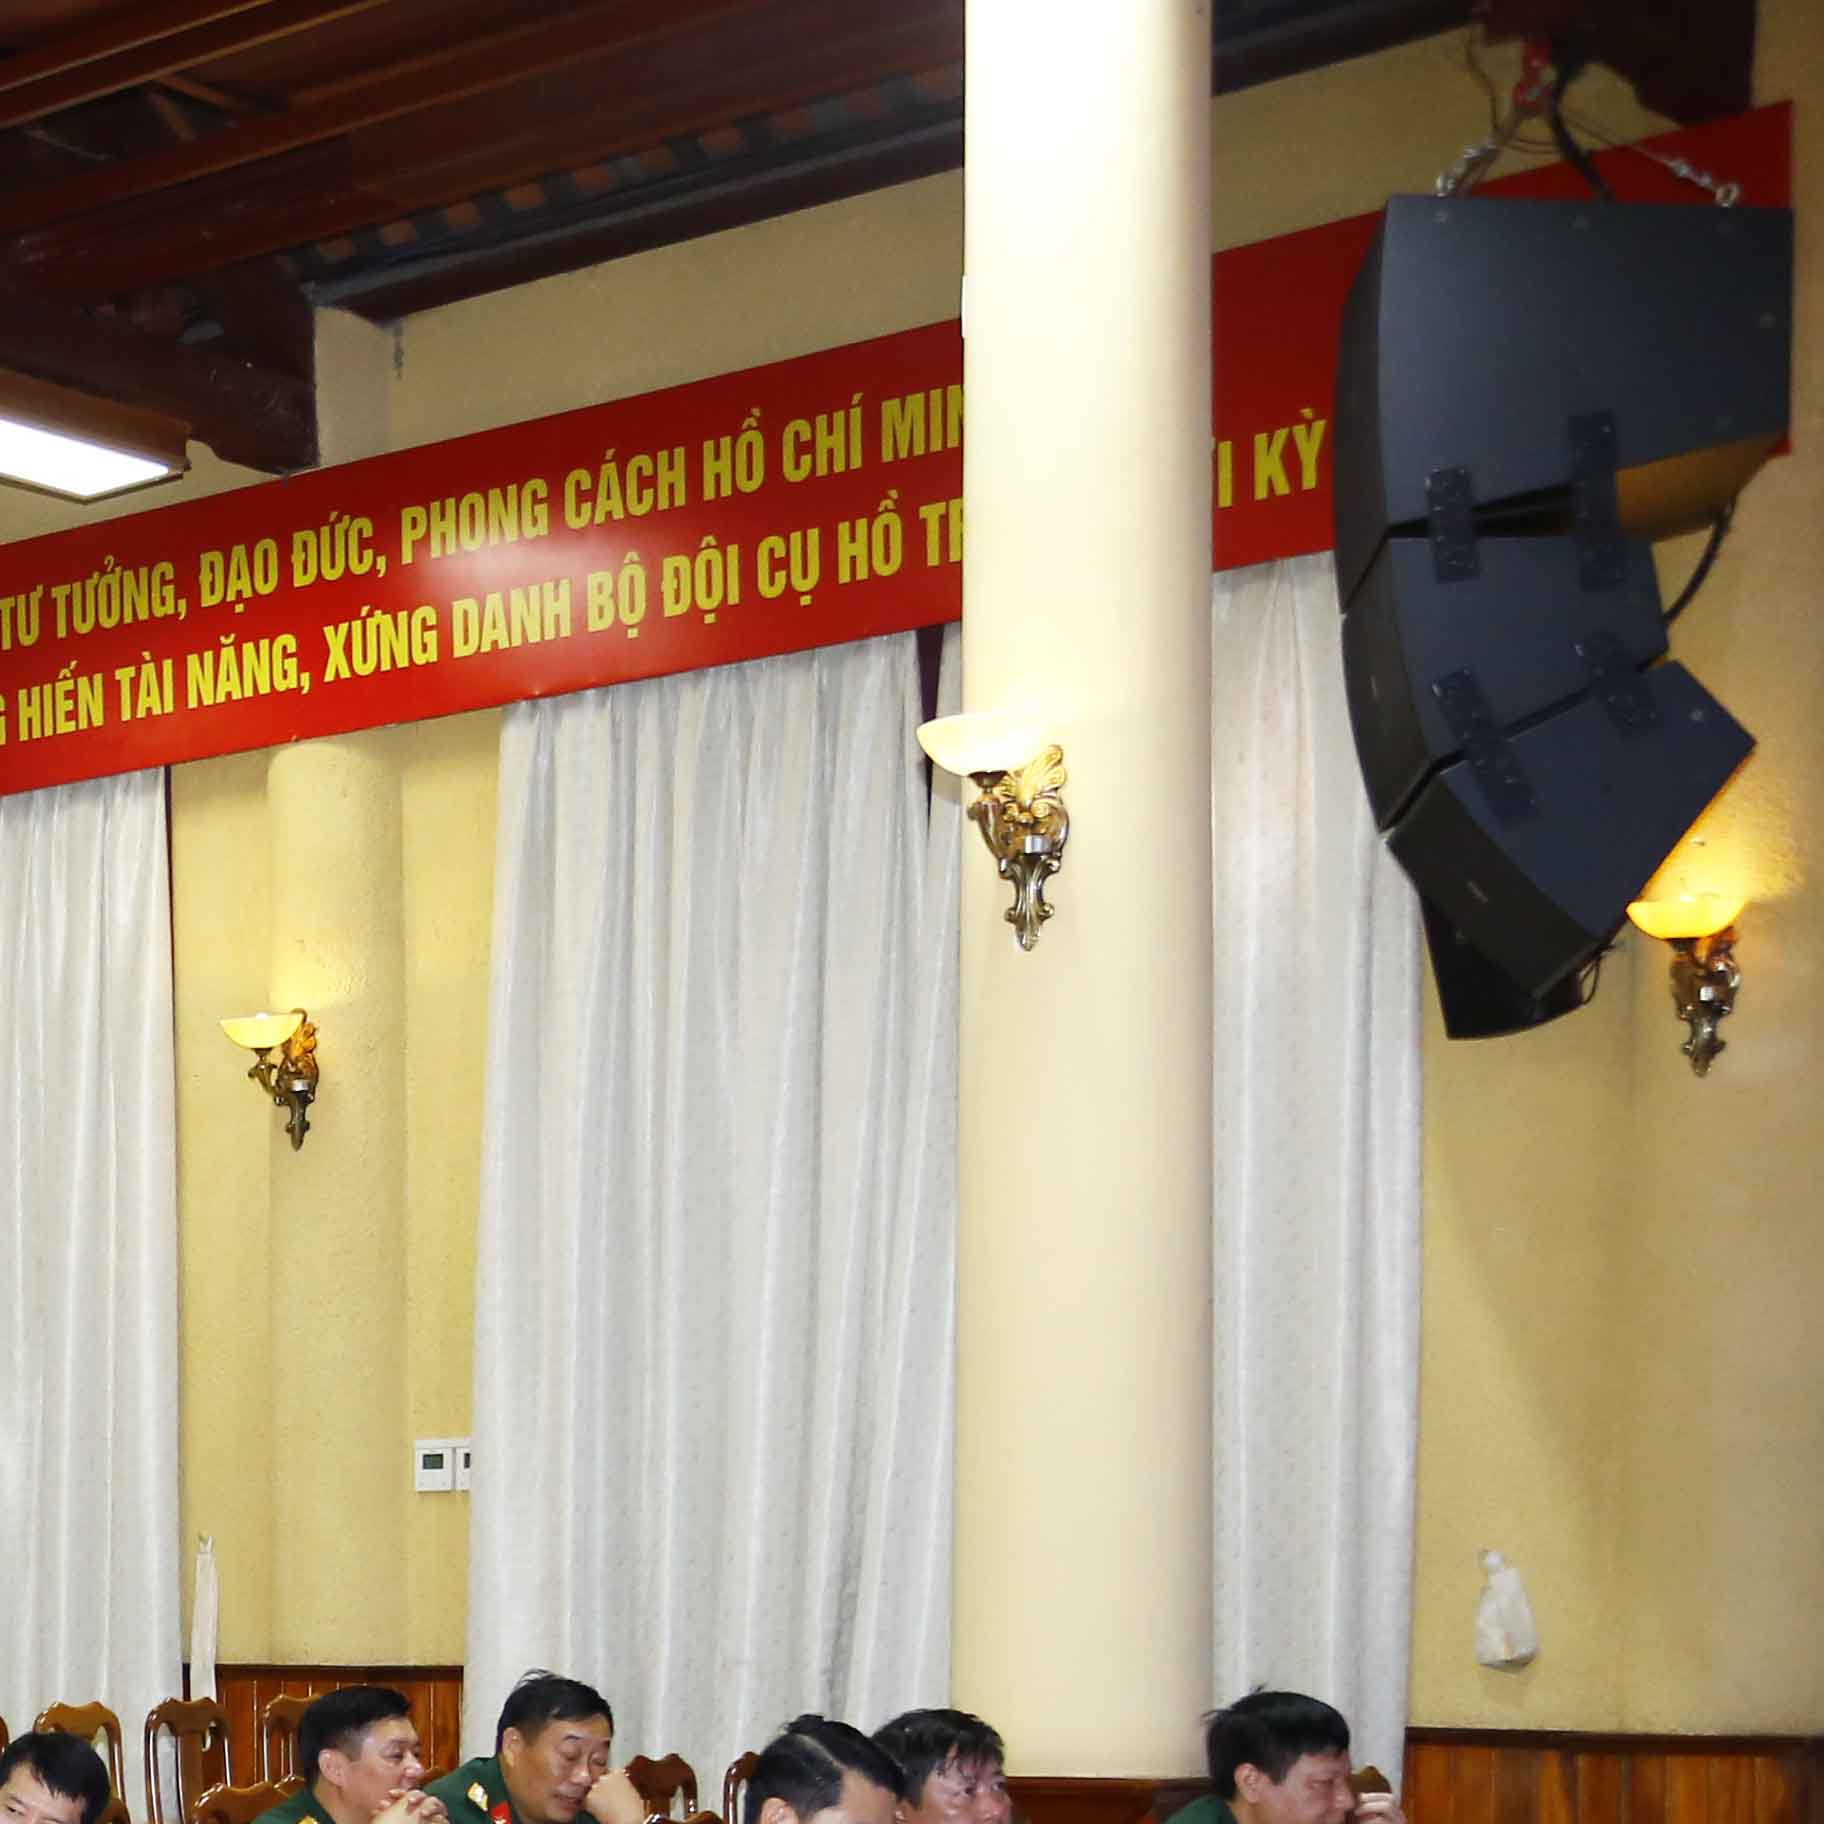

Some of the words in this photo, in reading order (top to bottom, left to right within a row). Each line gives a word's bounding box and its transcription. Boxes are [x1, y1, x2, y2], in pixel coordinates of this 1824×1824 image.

[51, 554, 187, 639] TƯỞNG,
[198, 537, 280, 613] ĐẠO
[291, 510, 387, 589] ĐỨC,
[400, 475, 549, 566] PHONG
[563, 447, 687, 530] CÁCH
[702, 407, 766, 502] HỒ
[782, 393, 864, 483] CHÍ
[1253, 407, 1327, 501] KỲ
[17, 660, 105, 744] HIẾN
[115, 651, 174, 722] TÀI
[186, 632, 311, 711] NĂNG,
[322, 605, 438, 684] XỨNG
[451, 577, 572, 659] DANH
[586, 551, 648, 640] BỘ
[661, 534, 741, 625] ĐỘI
[756, 527, 822, 607] CỤ
[836, 488, 904, 577] HỒ
